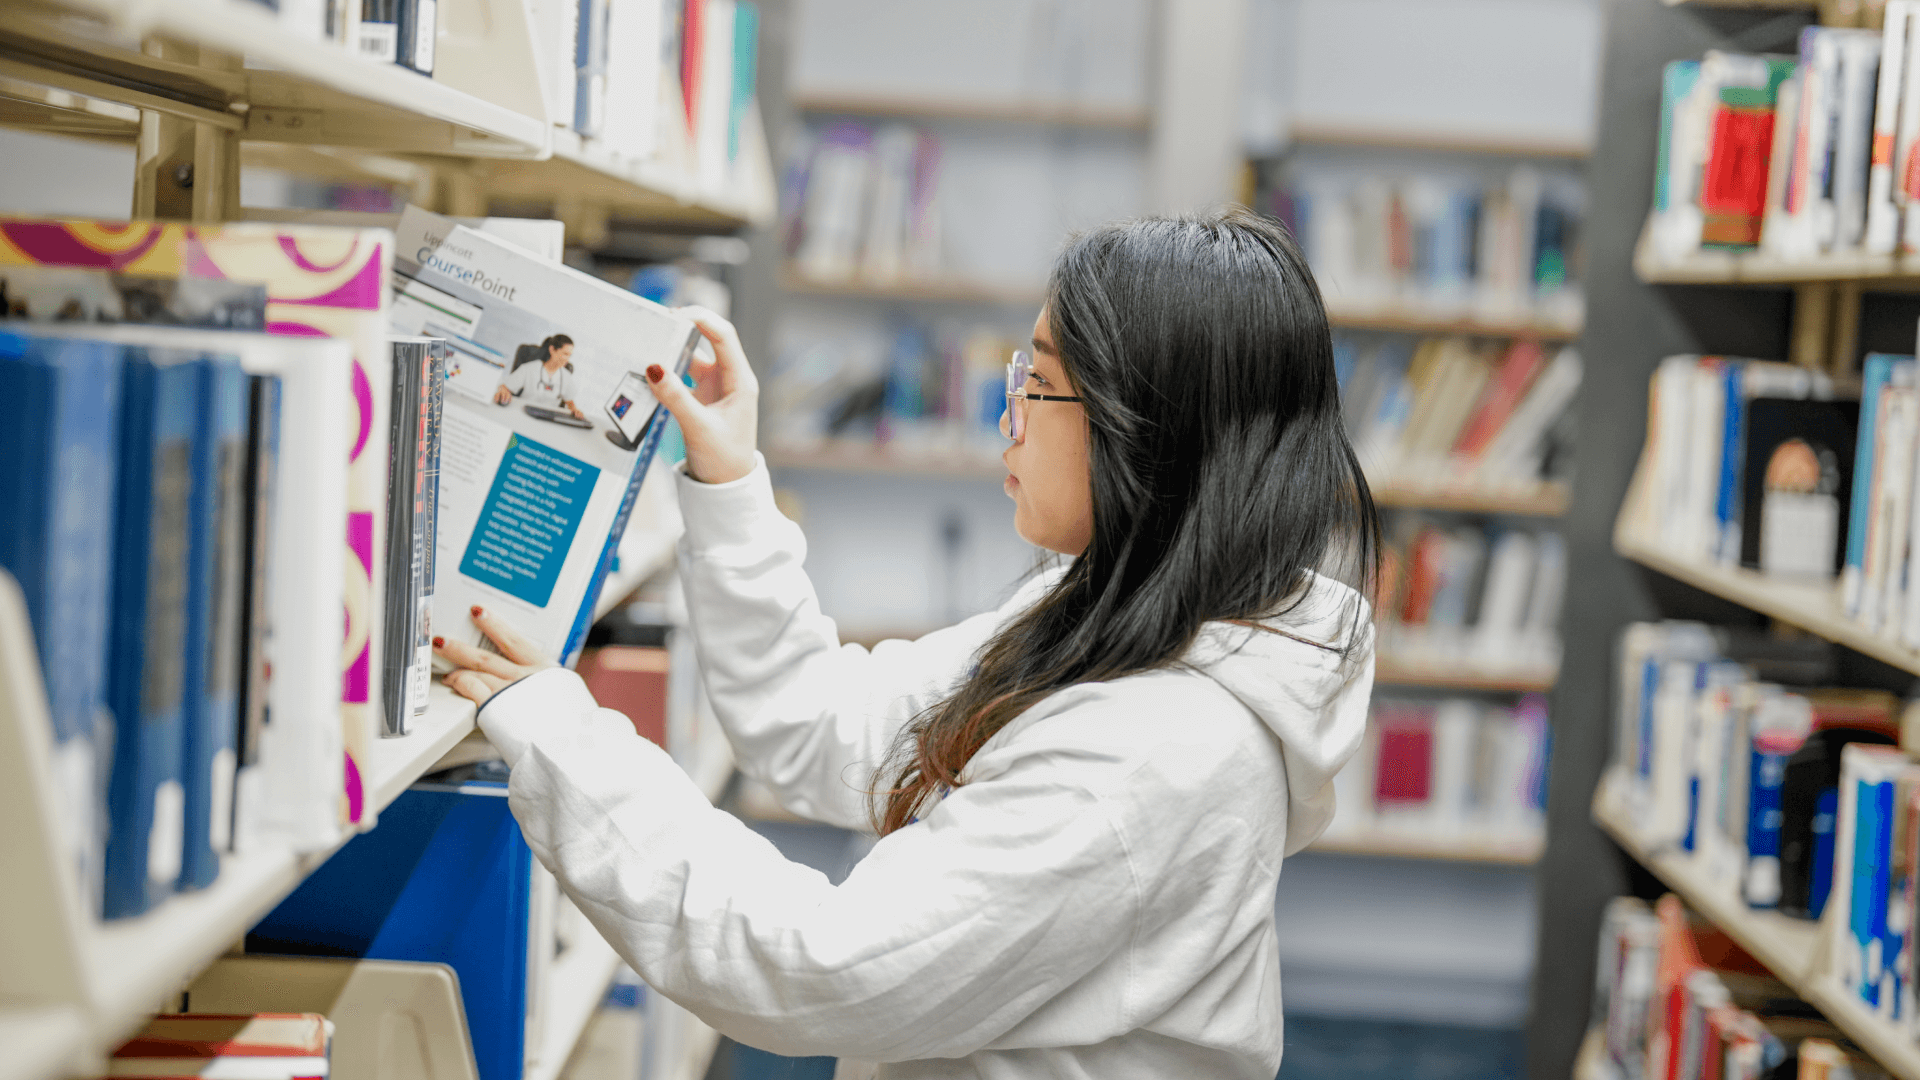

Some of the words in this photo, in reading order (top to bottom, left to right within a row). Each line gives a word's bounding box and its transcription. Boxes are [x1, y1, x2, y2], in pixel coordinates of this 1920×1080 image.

[424, 231, 473, 260] Lippincott
[416, 246, 517, 302] CoursePoint
[425, 356, 435, 458] KENNEDY
[433, 357, 444, 438] EDWARD
[427, 487, 435, 517] True
[425, 519, 434, 575] Compass
